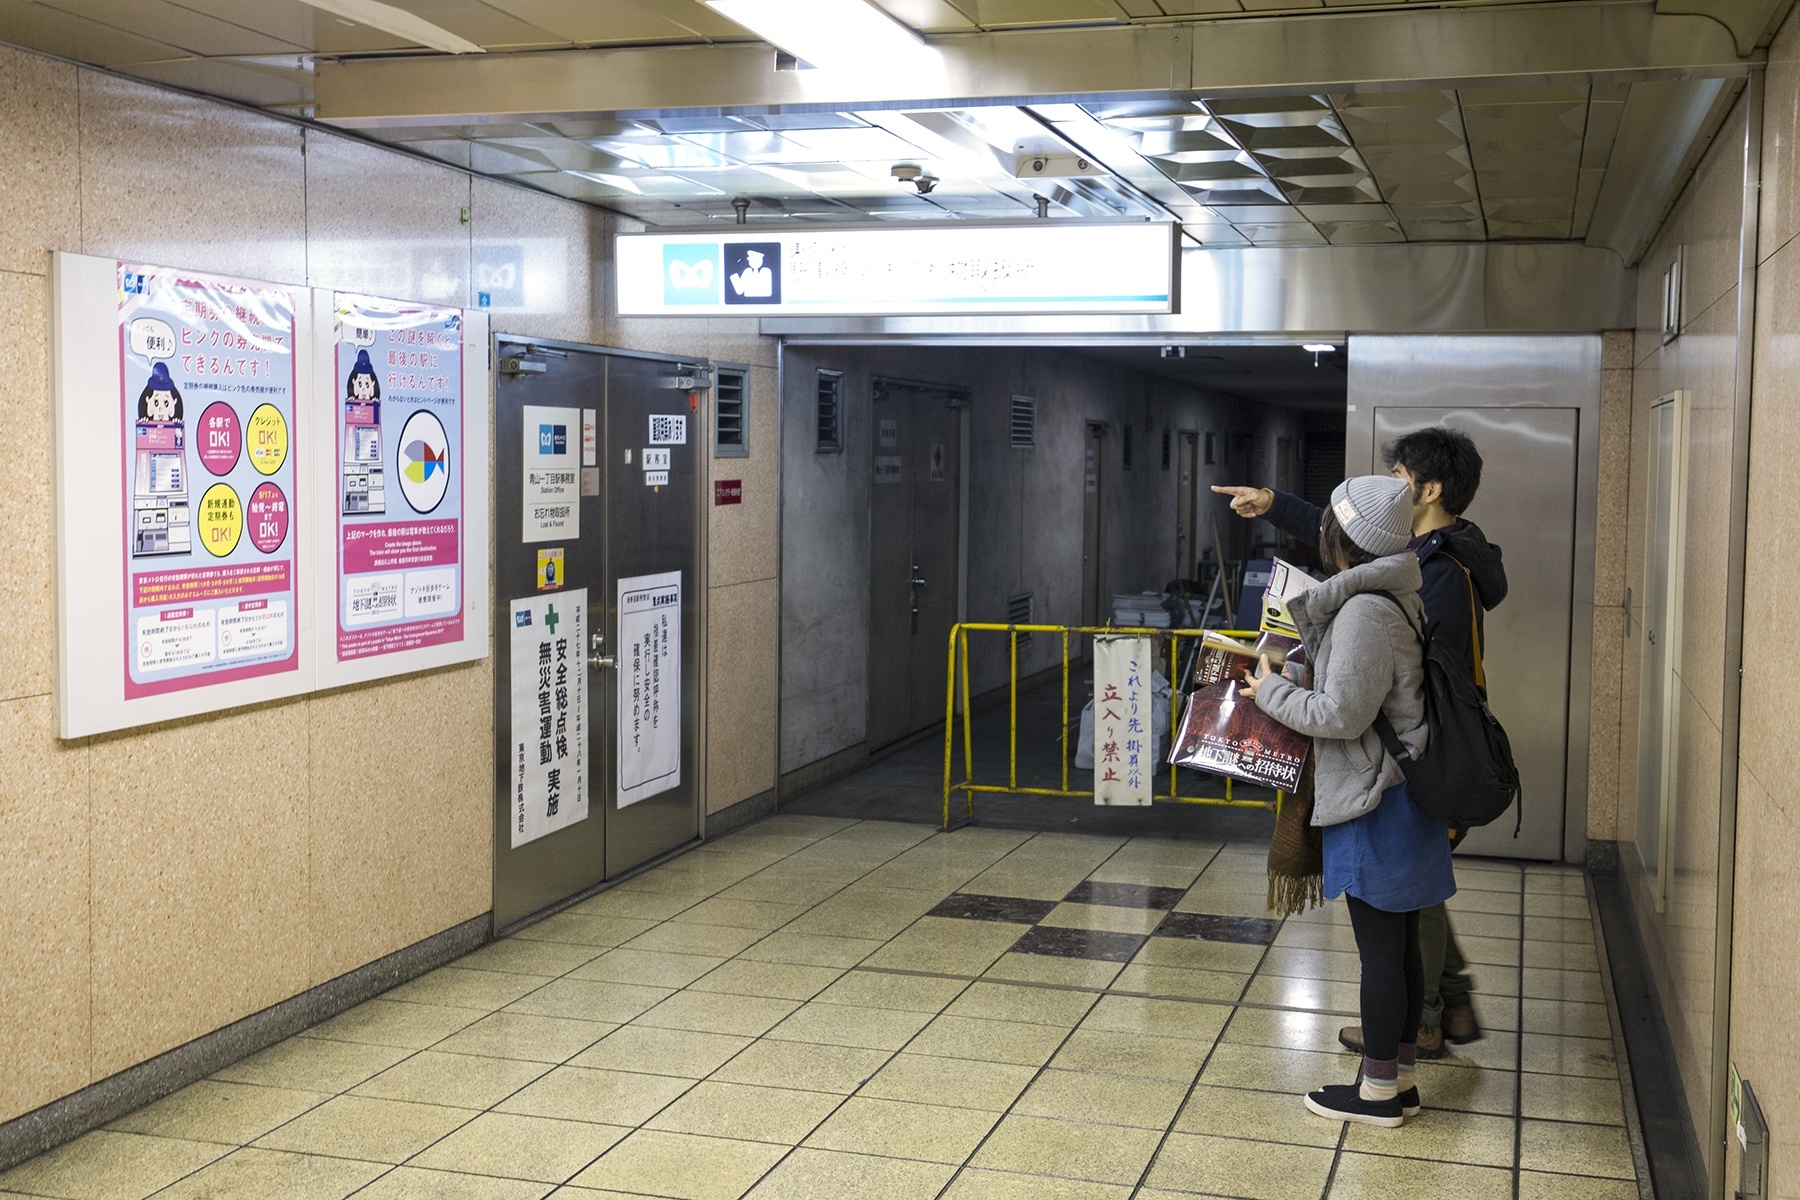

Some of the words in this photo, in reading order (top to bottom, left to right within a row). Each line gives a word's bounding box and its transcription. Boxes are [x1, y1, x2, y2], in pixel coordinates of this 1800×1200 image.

[147, 336, 165, 351] 便利
[181, 354, 271, 379] できるんです！
[387, 350, 438, 369] 最後の駅に
[387, 372, 450, 392] 行けるんです！
[208, 416, 231, 429] 各駅で
[254, 416, 281, 427] クレジット
[209, 430, 231, 448] OK!
[258, 430, 278, 445] OK!
[540, 486, 553, 494] Station
[554, 486, 565, 494] Office
[207, 511, 235, 522] 定期券も
[263, 513, 273, 521] まで
[534, 506, 571, 519] お忘れ物取扱所
[259, 522, 279, 538] OK!
[540, 520, 549, 528] Lost
[552, 520, 565, 528] Found
[211, 527, 232, 542] OK!
[643, 632, 652, 722] 実行し安全の
[538, 641, 553, 767] 無災害運動
[554, 637, 569, 760] 安全総点検
[632, 642, 642, 753] 確保に努めます。
[1101, 683, 1124, 783] 立入り禁止
[1203, 733, 1239, 747] TOKYO
[1263, 749, 1301, 764] METRO
[517, 742, 525, 834] 東京地下鉄株式会社
[546, 767, 561, 818] 実施
